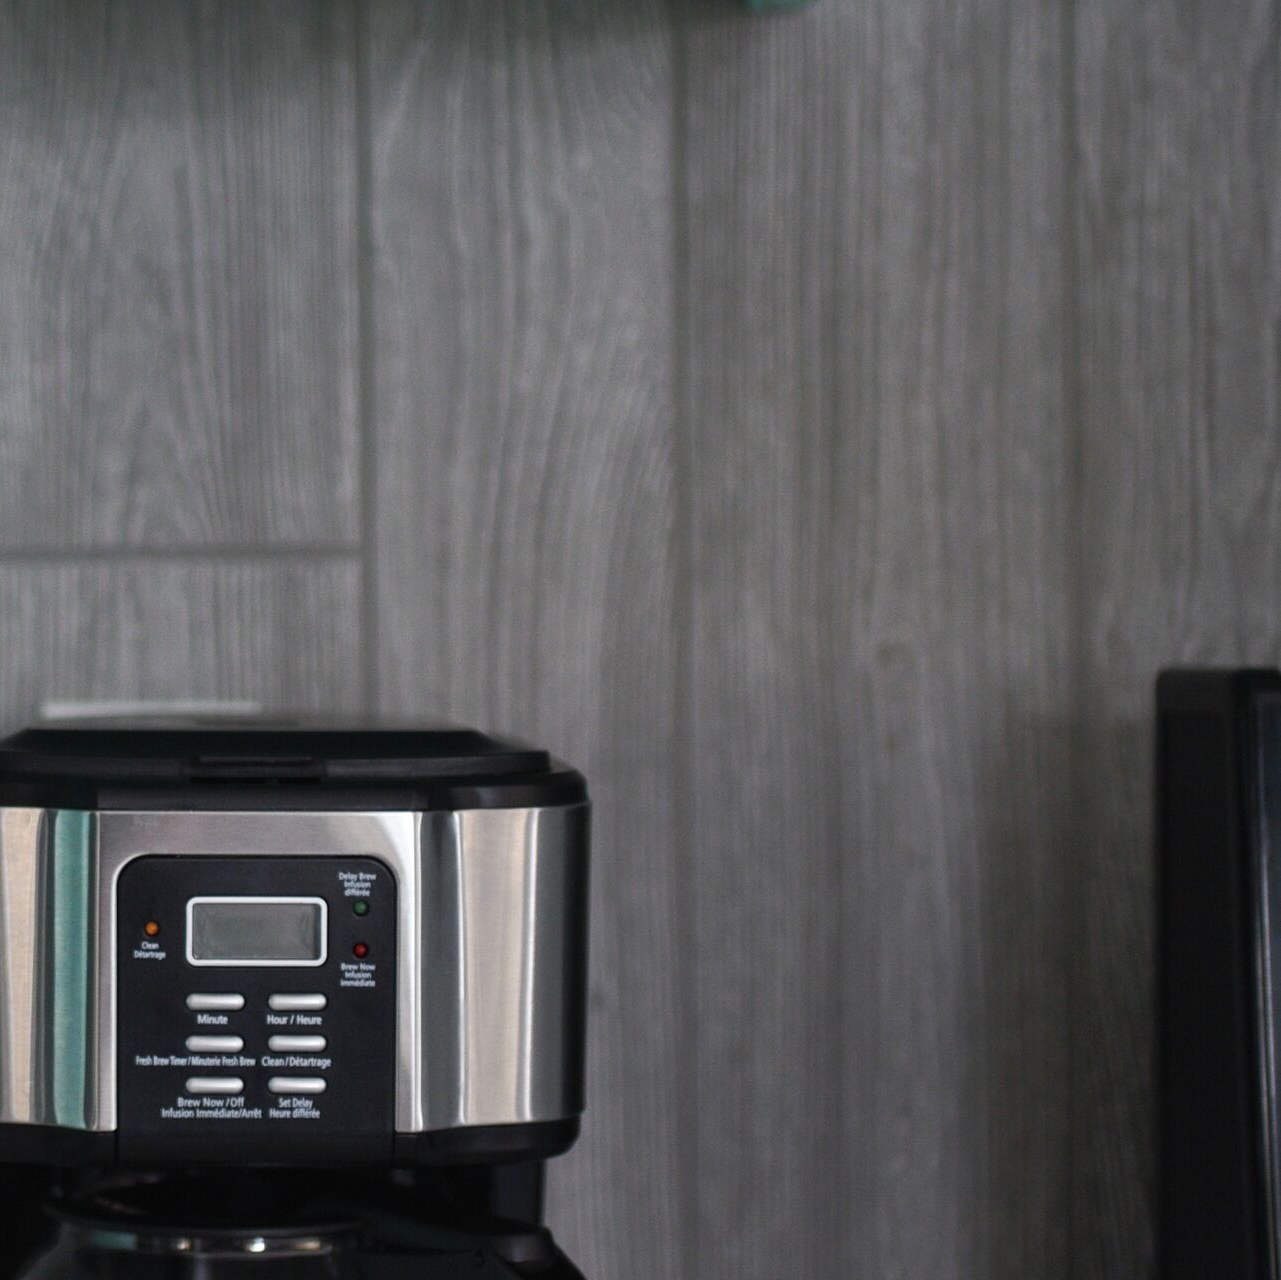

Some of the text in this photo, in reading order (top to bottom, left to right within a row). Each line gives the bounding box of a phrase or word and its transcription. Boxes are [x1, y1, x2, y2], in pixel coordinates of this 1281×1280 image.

[338, 872, 377, 881] Delay Brew
[344, 880, 371, 888] Infusion
[141, 941, 159, 950] Clean
[341, 963, 376, 971] Brew Now
[345, 971, 372, 979] Infusion
[197, 1014, 228, 1025] Minute
[267, 1014, 288, 1025] Hour
[296, 1014, 323, 1025] Heure
[135, 1056, 152, 1066] Fresh
[153, 1056, 169, 1066] Brew
[169, 1056, 188, 1066] Timer
[191, 1056, 221, 1066] Minuterie
[222, 1056, 238, 1066] Fresh
[239, 1056, 256, 1066] Brew
[261, 1056, 284, 1067] Clean
[177, 1097, 200, 1107] Brew
[203, 1097, 224, 1107] Now
[278, 1097, 314, 1109] Set Delay
[161, 1108, 194, 1118] Infusion
[269, 1108, 292, 1118] Heure
